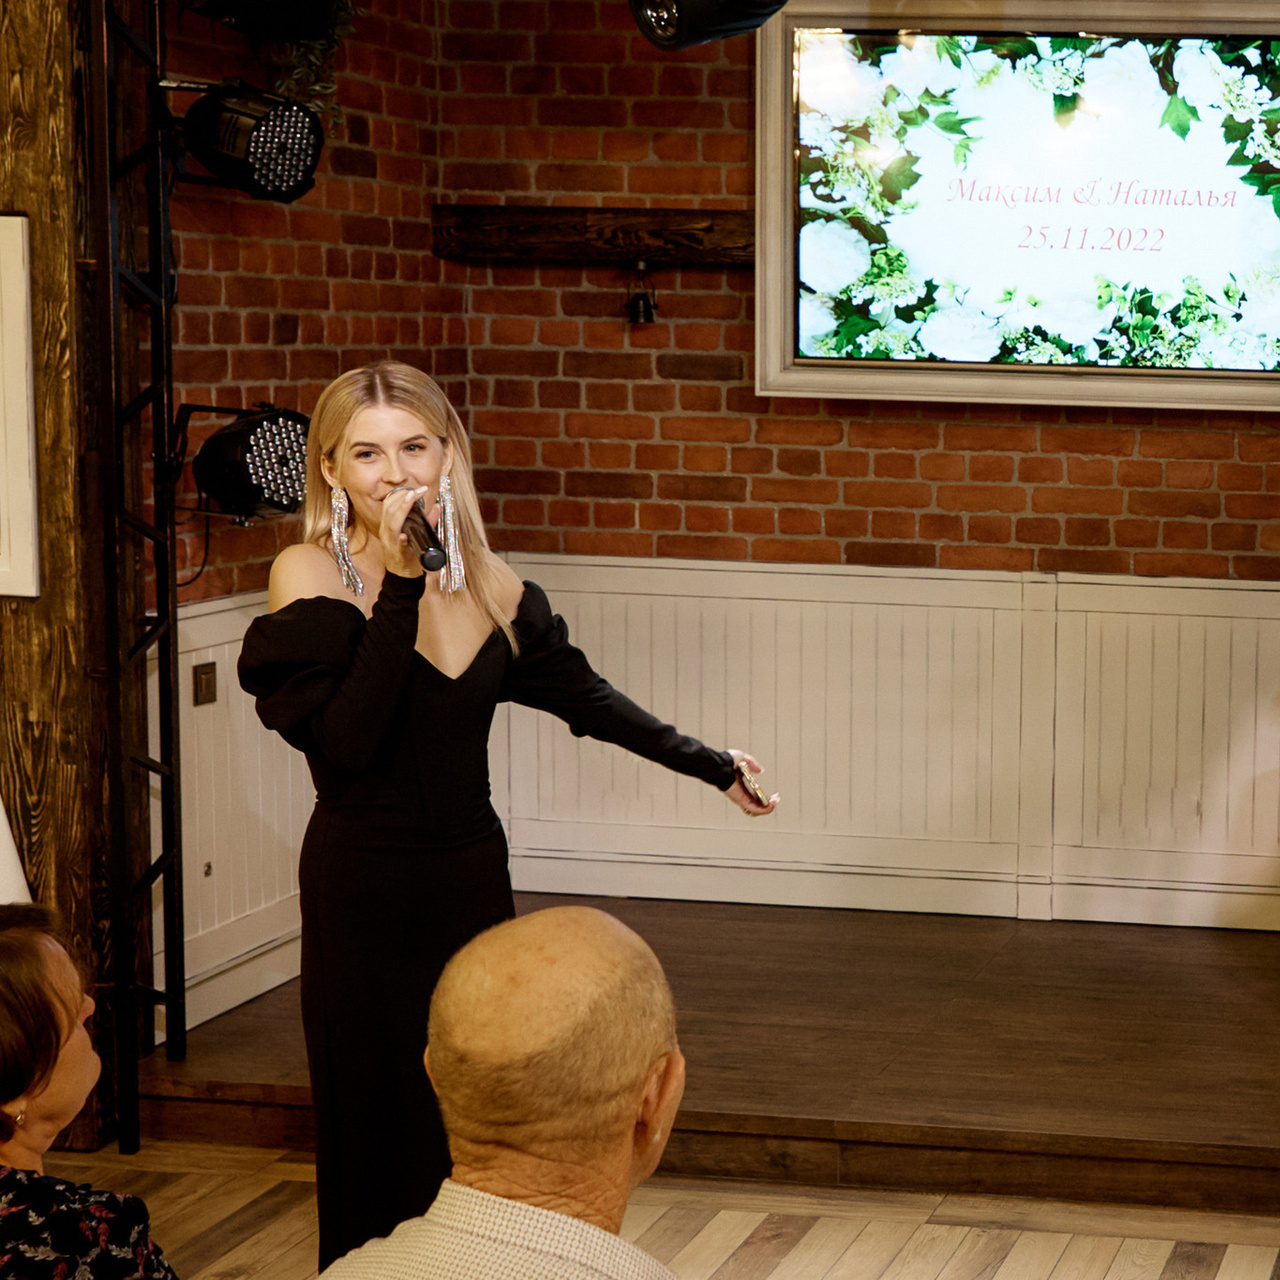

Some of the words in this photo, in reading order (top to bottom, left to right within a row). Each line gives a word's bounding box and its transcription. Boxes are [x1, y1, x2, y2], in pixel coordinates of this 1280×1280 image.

[946, 177, 1062, 209] Максим
[1073, 177, 1102, 206] &
[1106, 179, 1237, 208] Наталья
[1018, 224, 1165, 252] 25.11.2022
